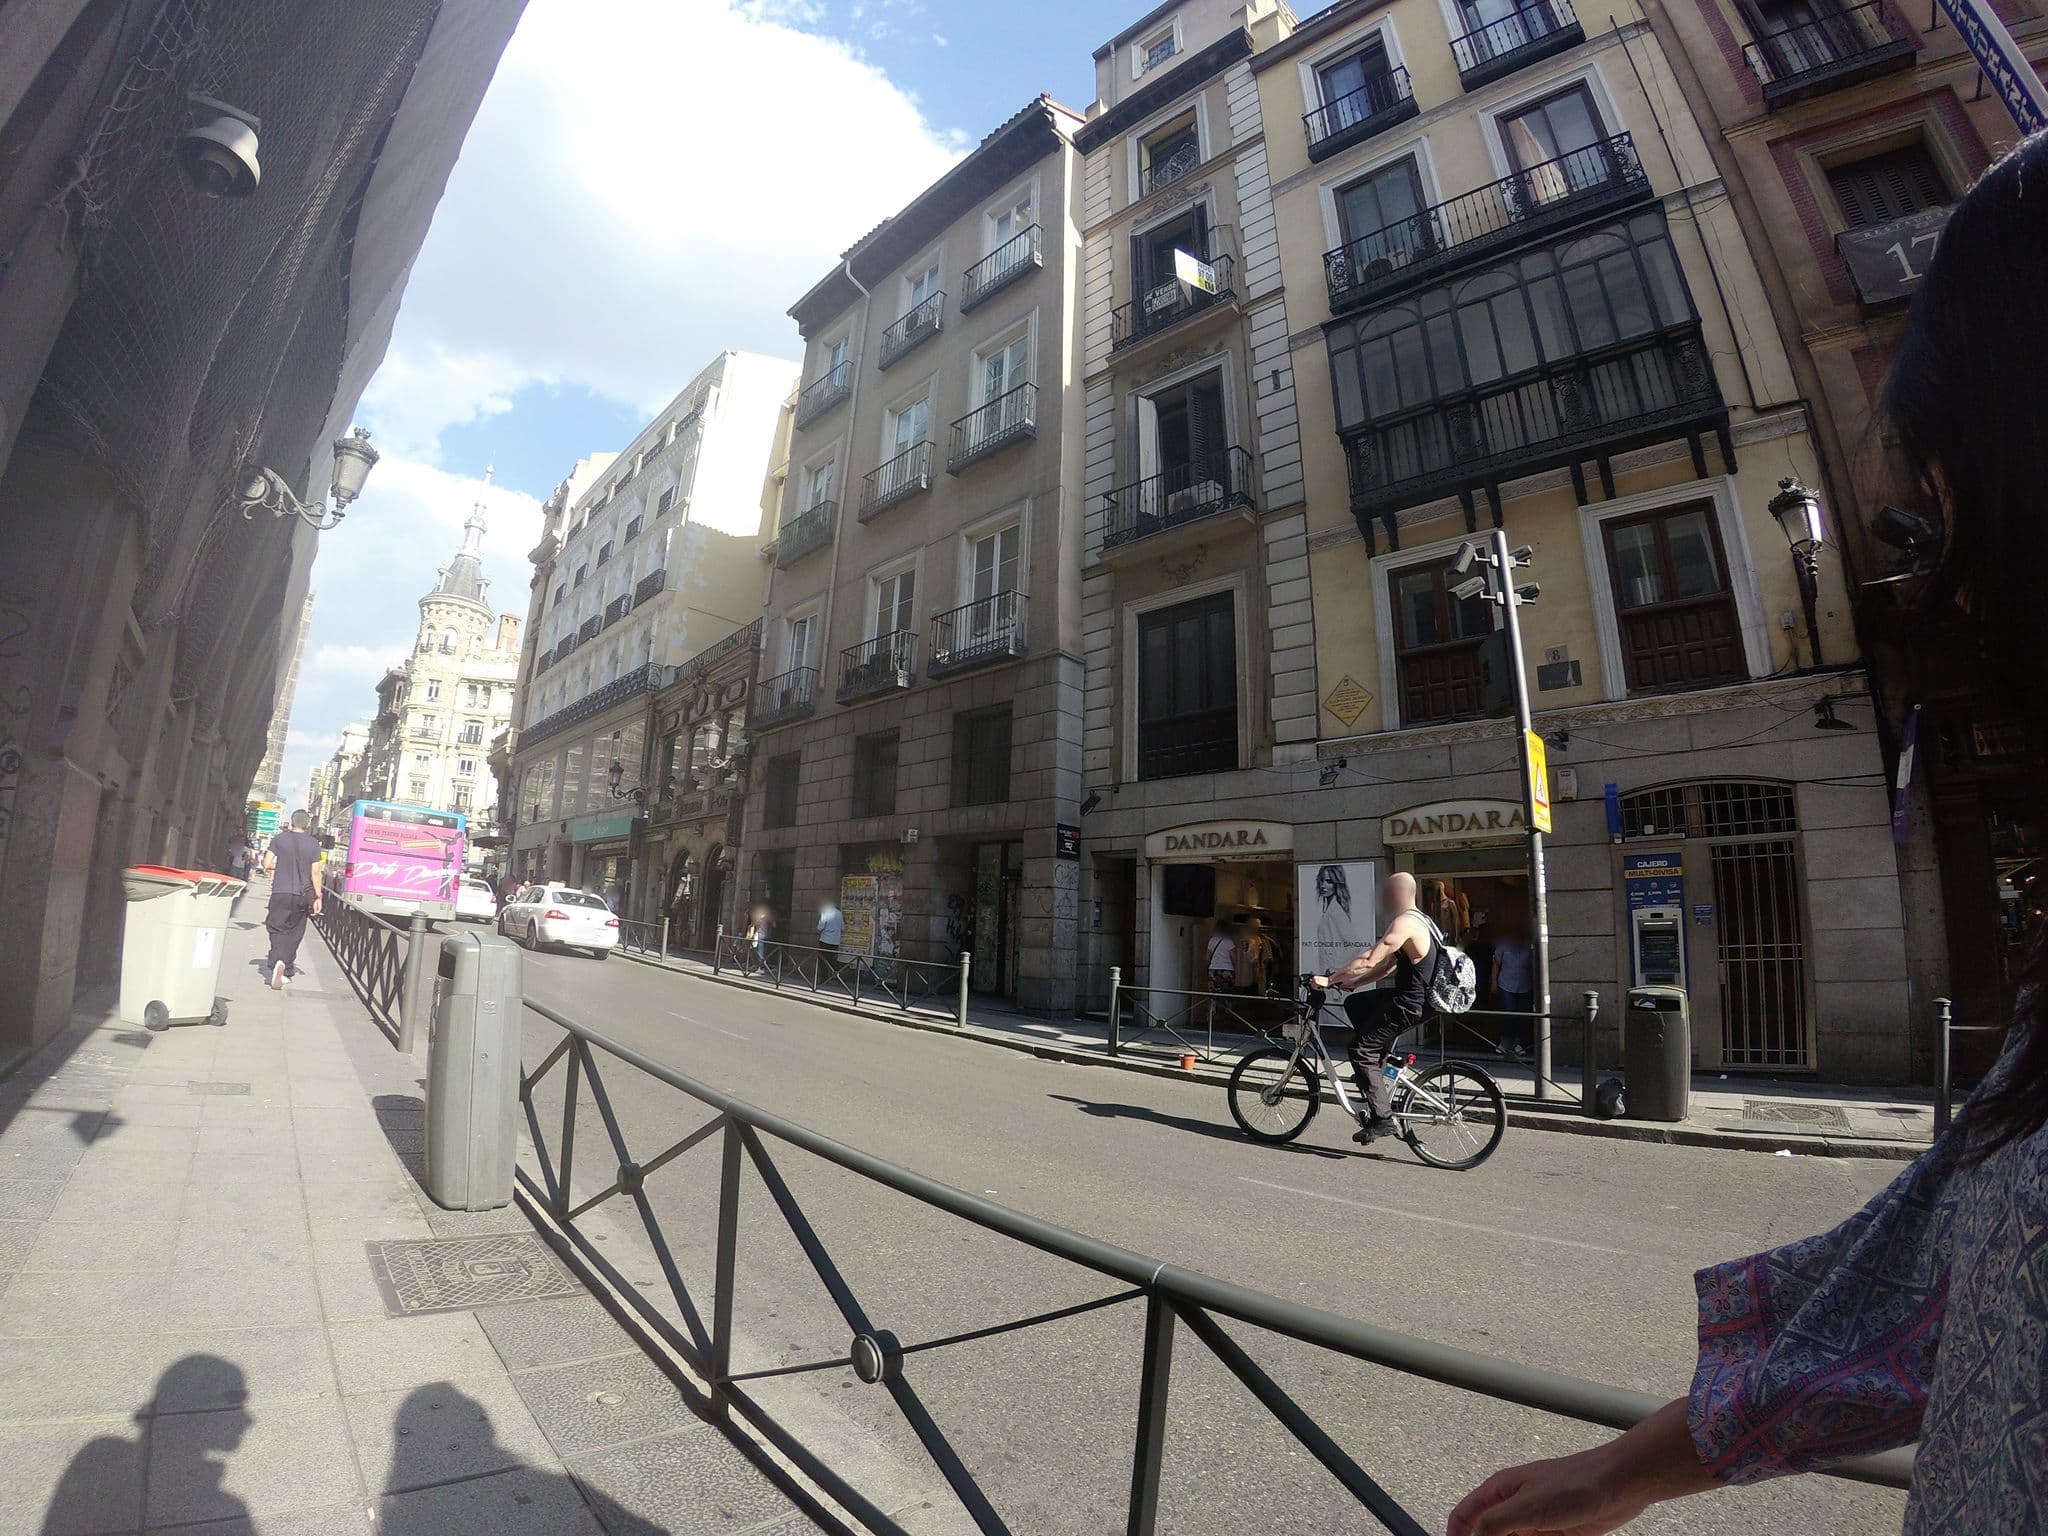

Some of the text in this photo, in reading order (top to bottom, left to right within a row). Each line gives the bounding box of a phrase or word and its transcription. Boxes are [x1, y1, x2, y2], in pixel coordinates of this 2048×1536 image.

[1552, 649, 1561, 661] 8
[1390, 807, 1524, 837] DANDARA
[1165, 828, 1268, 850] DANDARA
[1637, 860, 1668, 868] CAJERO
[1628, 868, 1679, 877] MULTI-DIVISA
